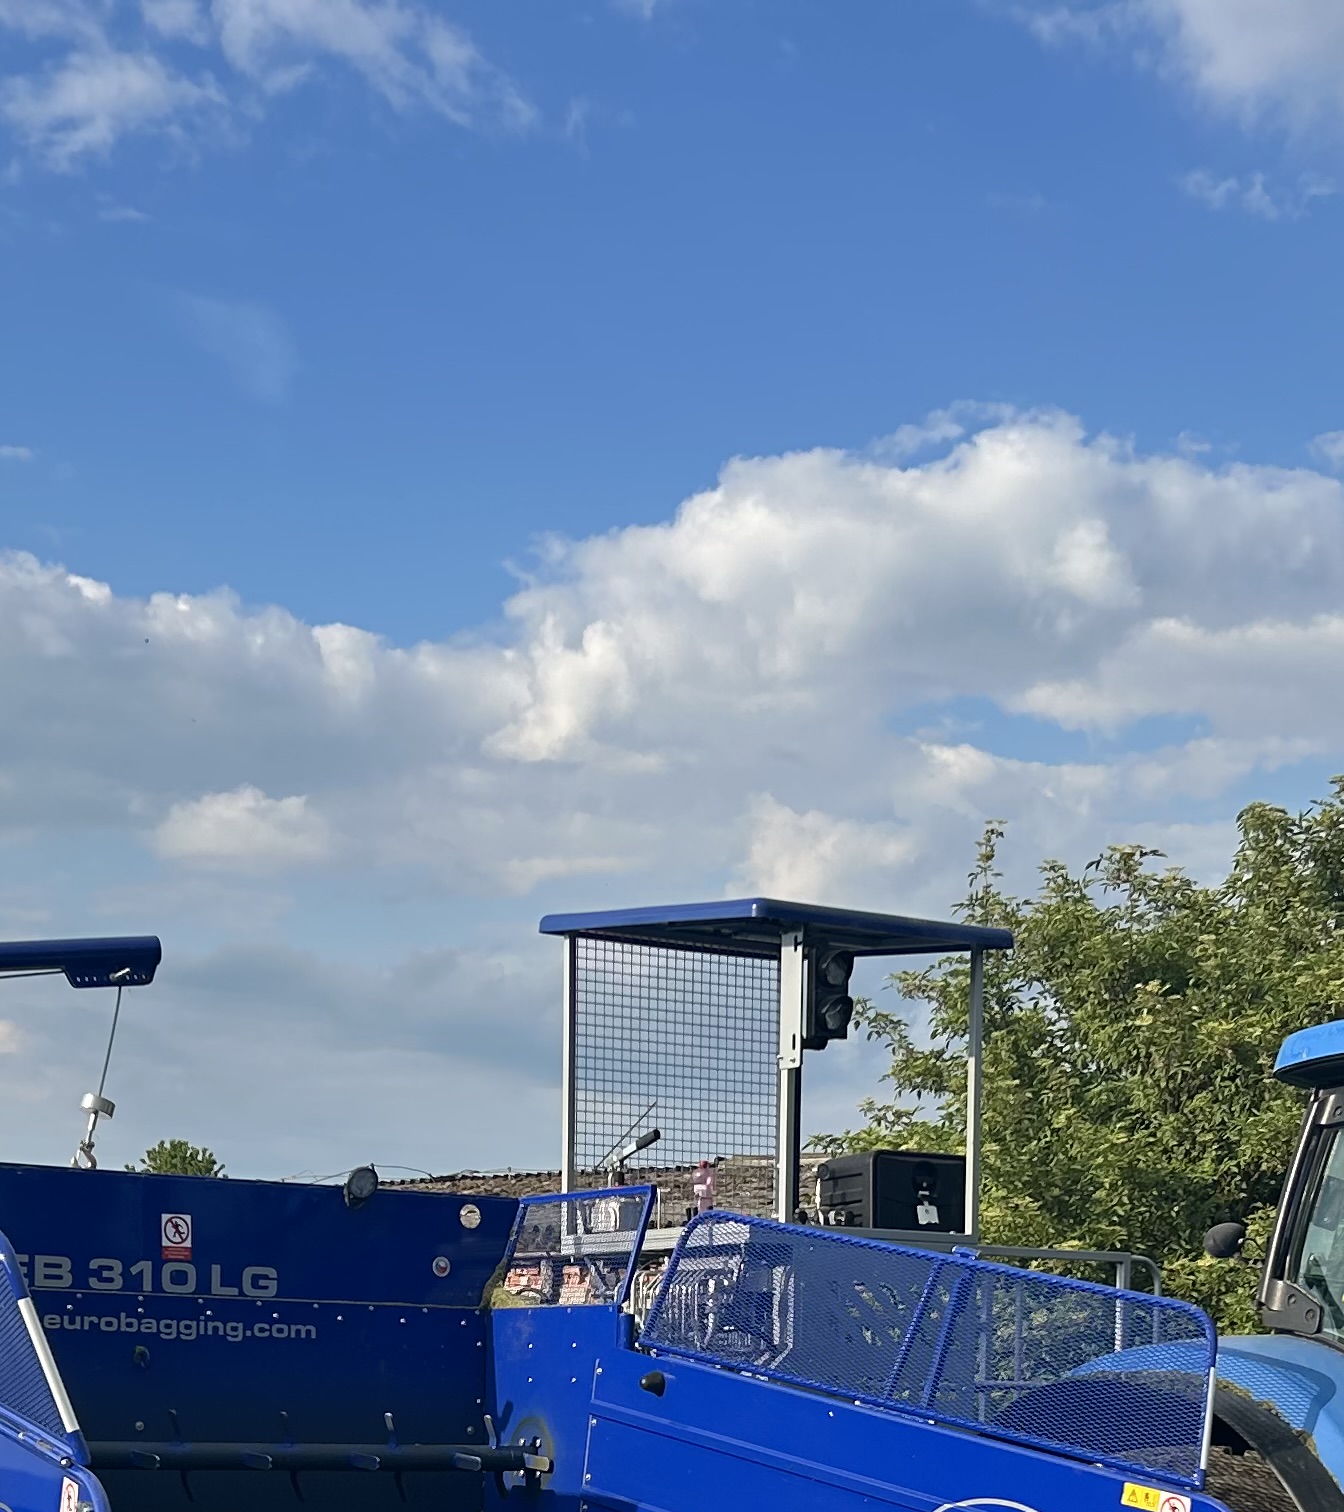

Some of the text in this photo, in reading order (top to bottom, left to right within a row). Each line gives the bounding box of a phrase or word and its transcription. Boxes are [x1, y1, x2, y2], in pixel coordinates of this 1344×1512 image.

[88, 1258, 197, 1294] 310
[210, 1264, 278, 1297] LG
[43, 1312, 318, 1342] eurobagging.com
